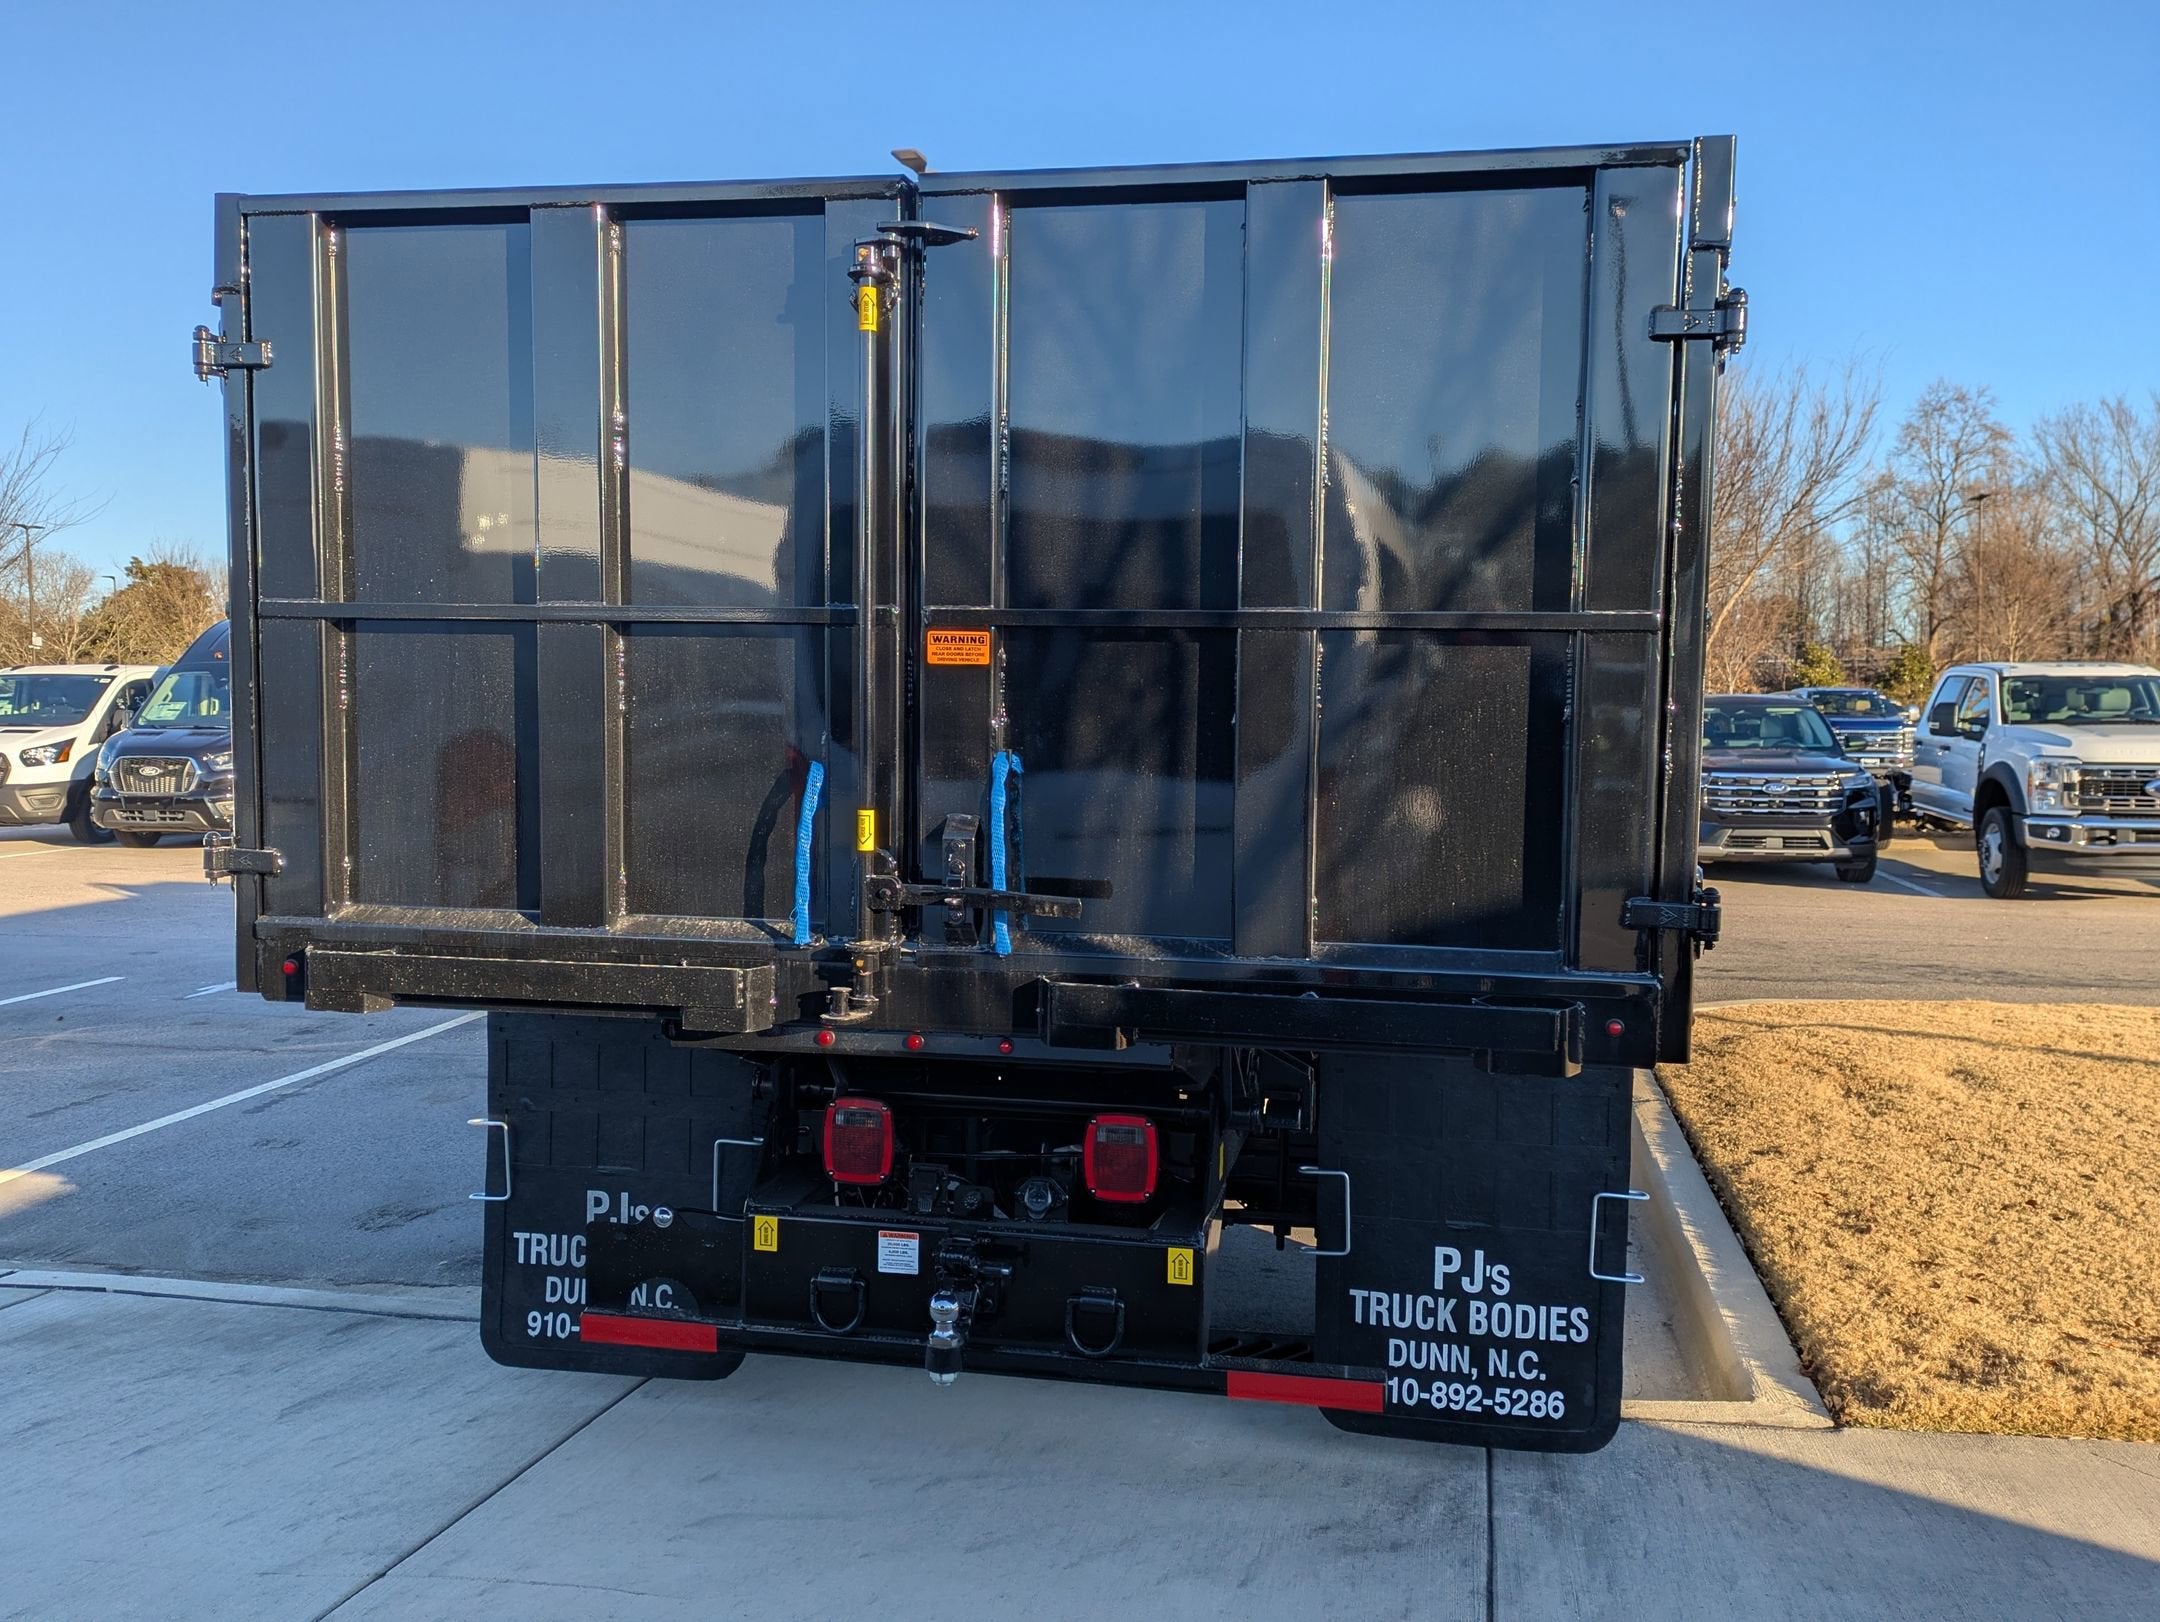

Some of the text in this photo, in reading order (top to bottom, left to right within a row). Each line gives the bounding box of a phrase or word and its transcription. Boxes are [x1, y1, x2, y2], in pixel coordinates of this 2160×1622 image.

[932, 636, 985, 644] WARNING
[513, 1231, 587, 1268] TRUC
[1434, 1246, 1511, 1296] PJ's
[630, 1283, 680, 1309] N.C.
[1349, 1289, 1590, 1344] TRUCK BODIES
[1387, 1338, 1547, 1381] DUNN, N.C.
[1387, 1376, 1565, 1420] 10-892-5286
